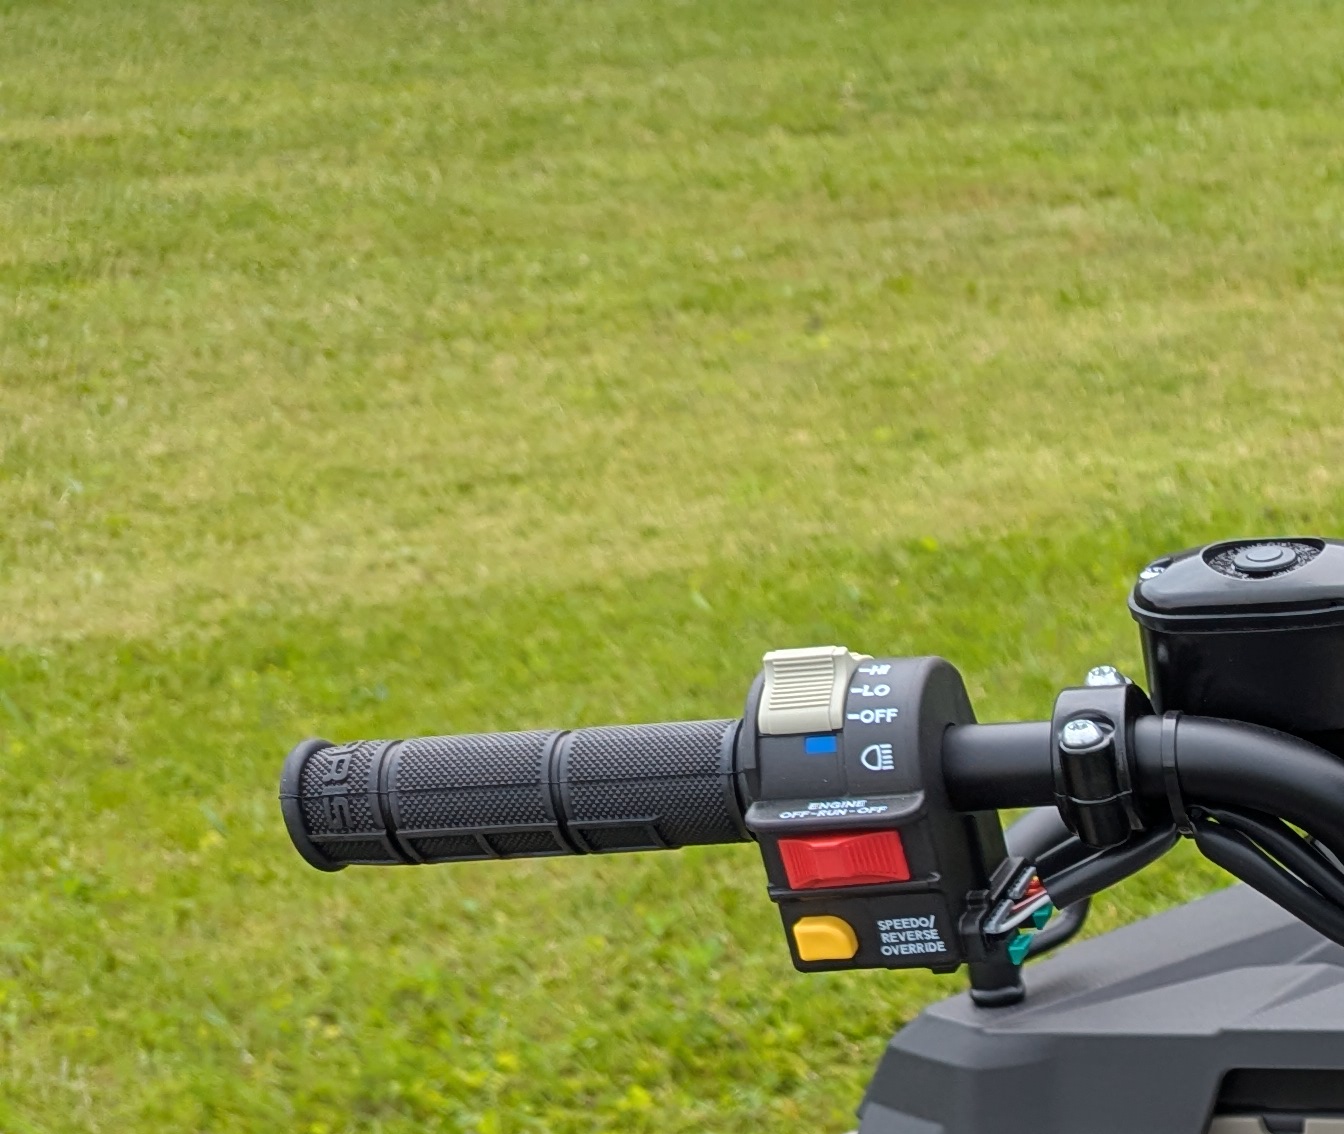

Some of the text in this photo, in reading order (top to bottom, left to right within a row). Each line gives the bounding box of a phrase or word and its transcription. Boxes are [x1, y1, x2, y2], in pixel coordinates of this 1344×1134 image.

[862, 684, 890, 697] LO
[860, 708, 898, 724] OFF
[808, 800, 867, 811] ENGINE
[877, 915, 936, 931] SPEEDO/
[881, 929, 940, 943] REVERSE
[880, 942, 946, 956] OVERRIDE
